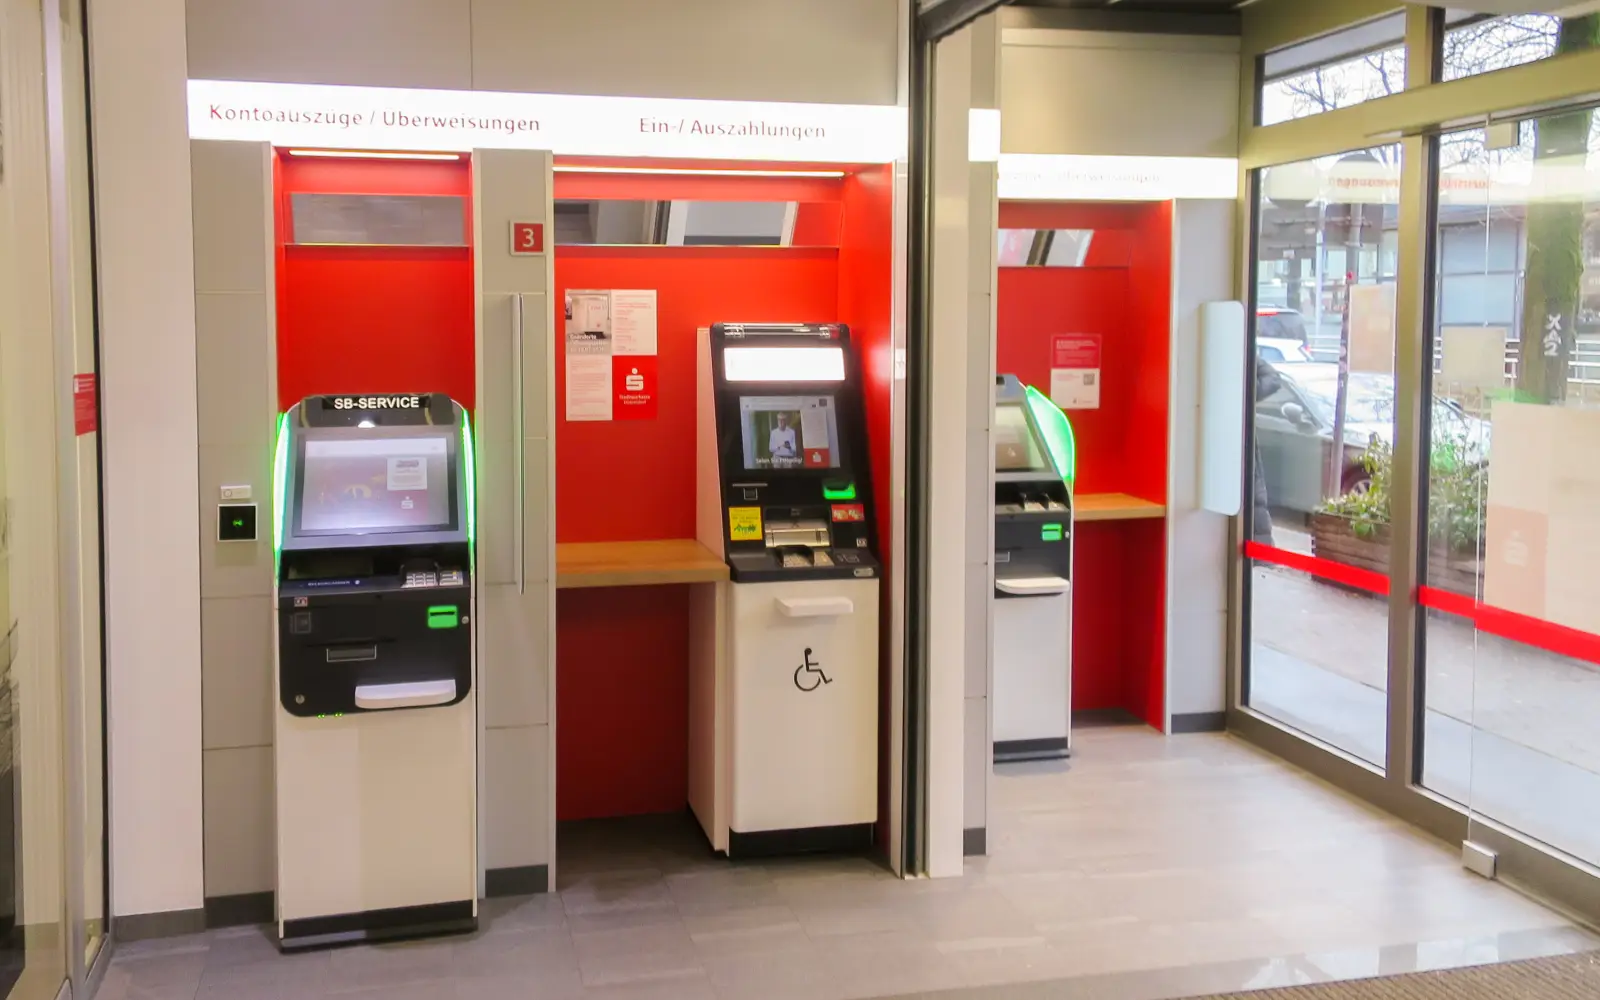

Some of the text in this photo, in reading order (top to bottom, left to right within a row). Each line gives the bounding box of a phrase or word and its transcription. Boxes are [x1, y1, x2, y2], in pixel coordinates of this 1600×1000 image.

[209, 104, 363, 129] Kontoauszüge
[369, 110, 376, 125] /
[690, 119, 826, 141] Auszahlungen
[522, 227, 535, 248] 3
[334, 396, 420, 410] SB-SERVICE
